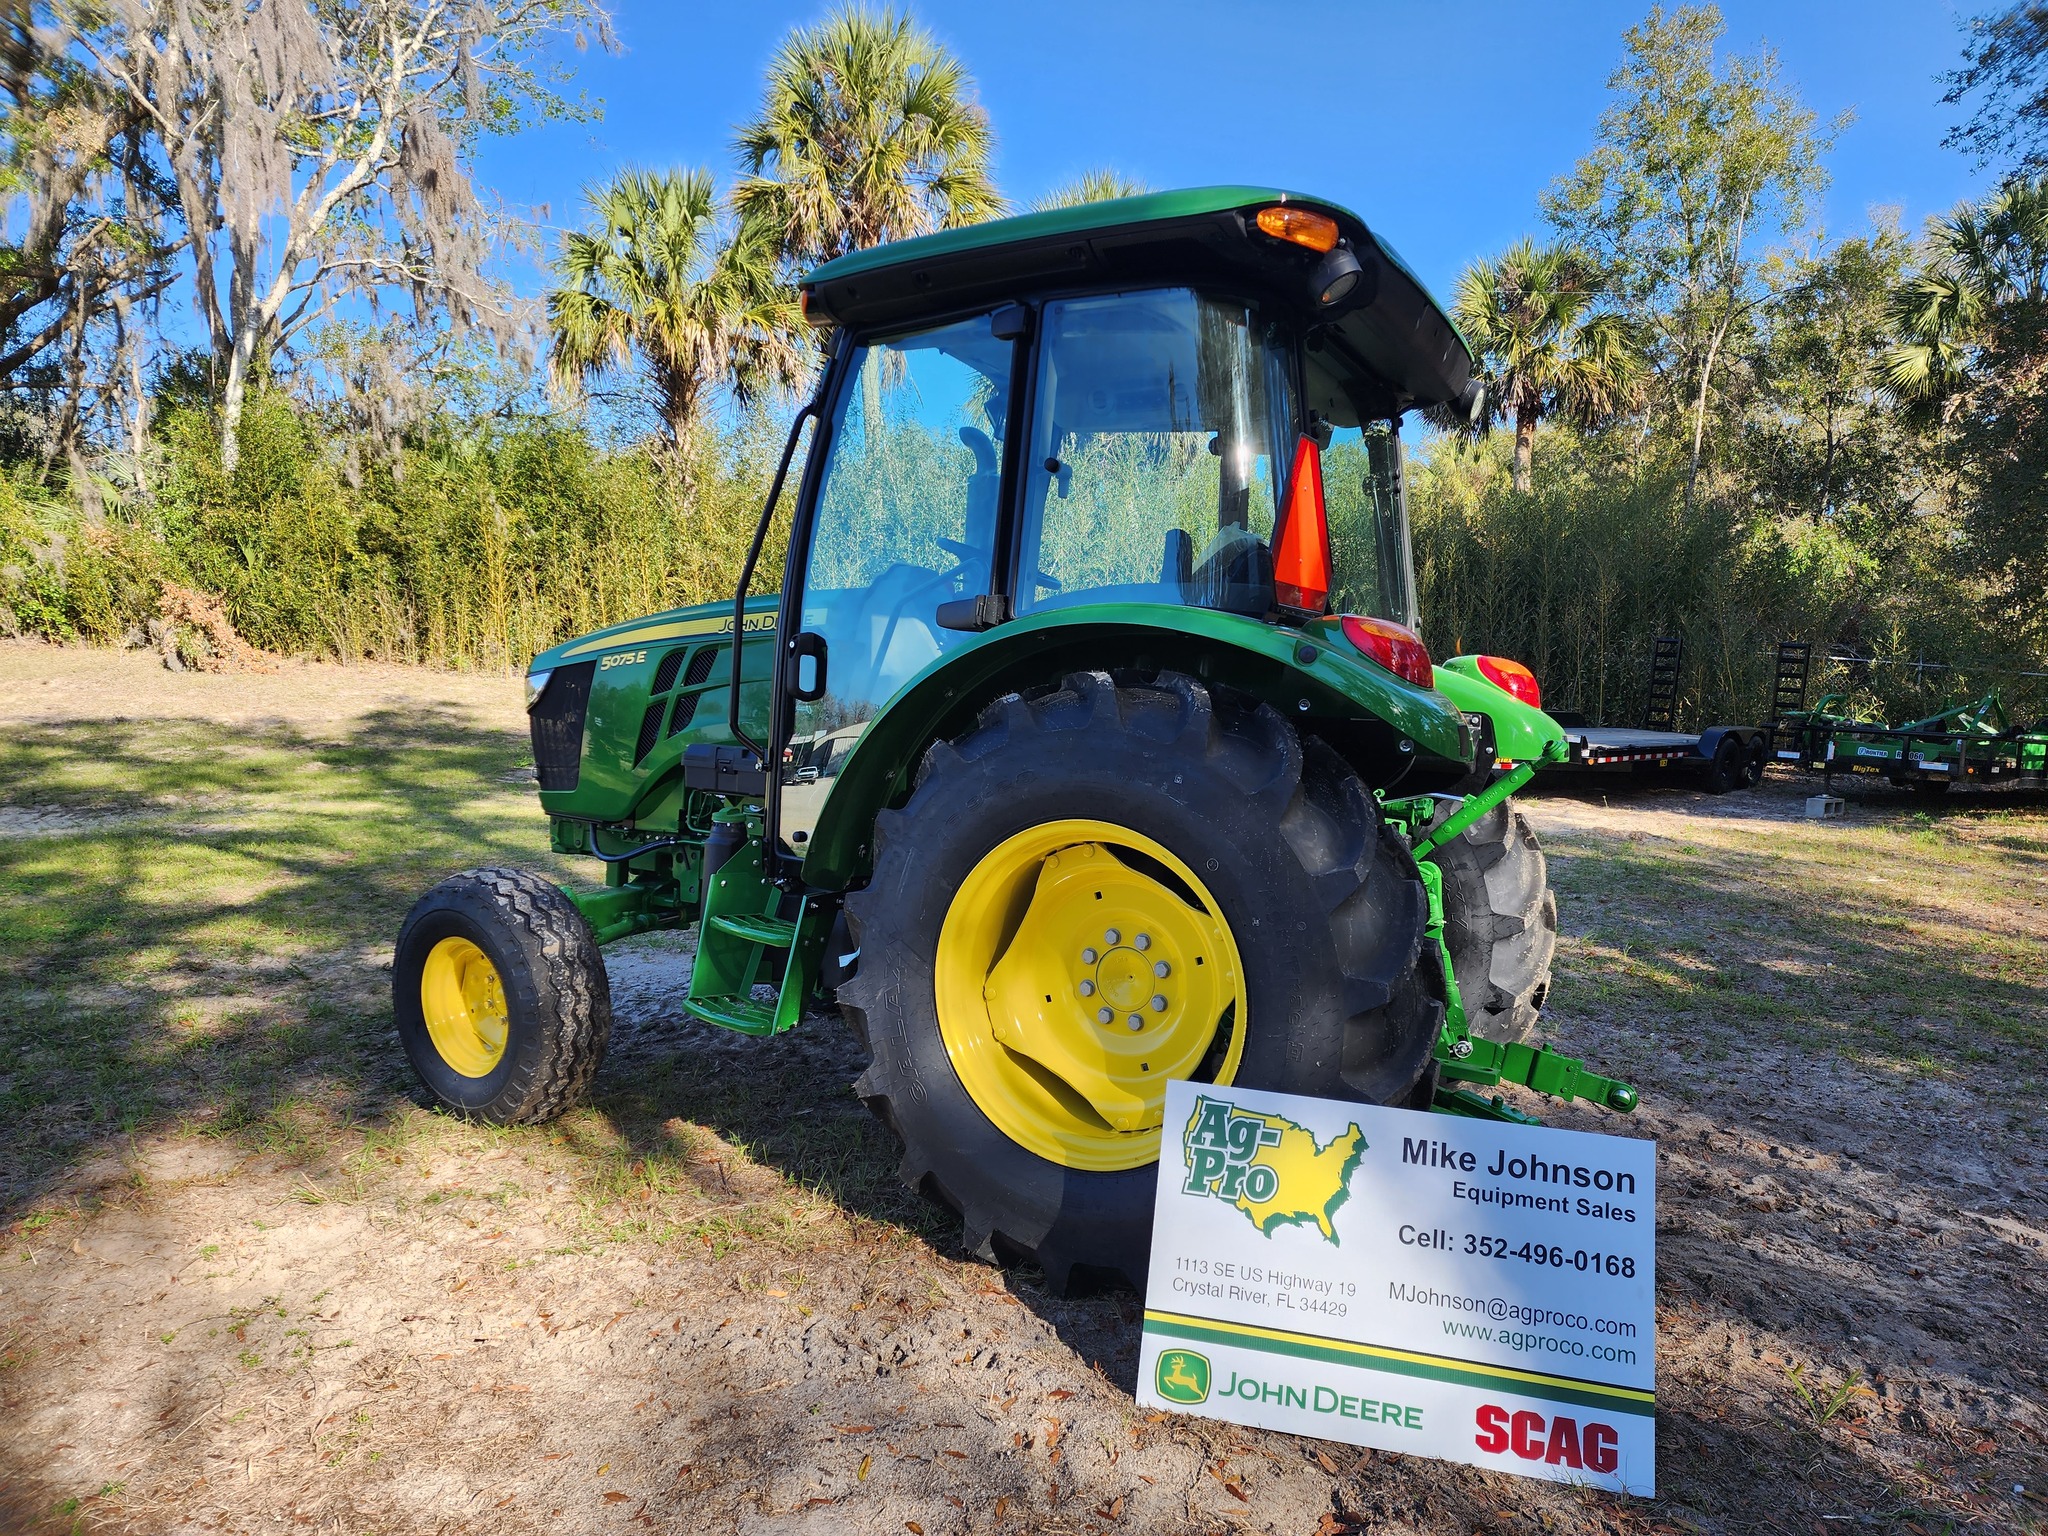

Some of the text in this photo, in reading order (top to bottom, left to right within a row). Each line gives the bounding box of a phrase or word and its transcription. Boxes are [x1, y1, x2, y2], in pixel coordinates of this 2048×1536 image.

[1182, 1147, 1278, 1203] Pro
[1402, 1137, 1636, 1194] Mike Johnson
[1453, 1181, 1636, 1223] Equipment Sales
[1176, 1257, 1356, 1297] 1113 SE US Highway 19
[1399, 1225, 1636, 1278] Cell: 352-496-0168
[1172, 1277, 1347, 1317] Crystal River, FL 34429
[1389, 1282, 1636, 1338] MJohnson@agproco.com
[1443, 1321, 1636, 1365] www.agproco.com
[1218, 1371, 1424, 1430] JOHN DEERE
[1475, 1404, 1619, 1473] SCAG
